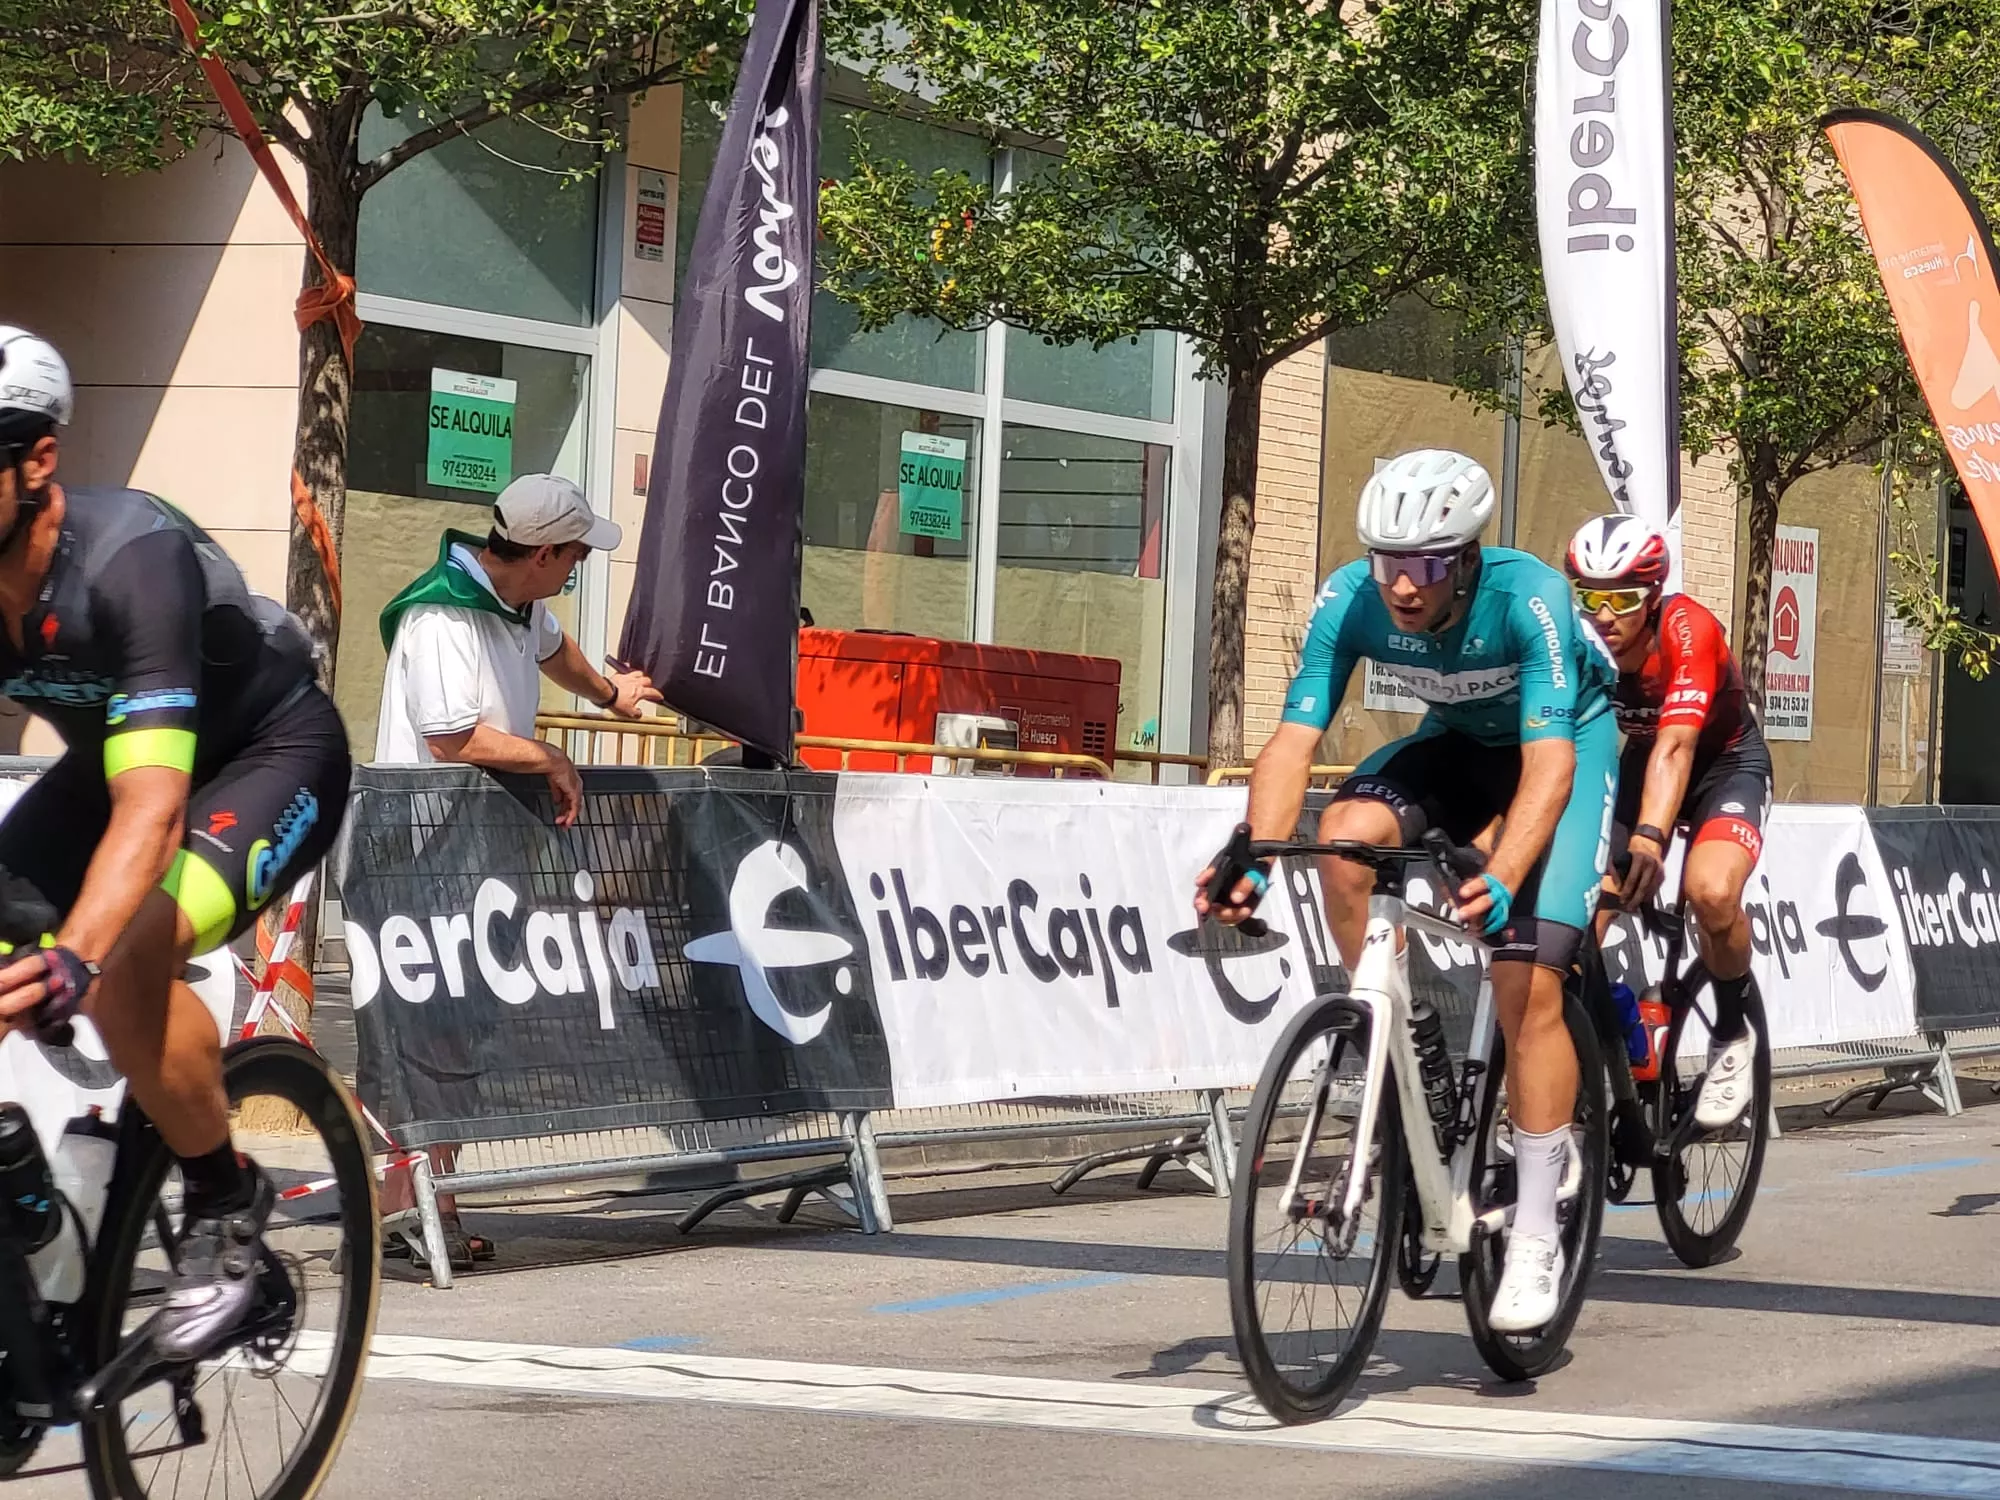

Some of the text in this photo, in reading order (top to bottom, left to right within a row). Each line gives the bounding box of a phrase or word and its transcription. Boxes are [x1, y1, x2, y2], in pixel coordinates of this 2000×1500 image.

[430, 404, 512, 439] SE ALQUILA
[442, 459, 497, 482] 974238244
[900, 463, 962, 491] SE ALQUILA
[1773, 537, 1815, 576] ALQUILER
[1528, 596, 1568, 690] CONTROLPACK
[1769, 696, 1781, 710] 974
[1782, 696, 1790, 711] 21
[1791, 697, 1801, 711] 53
[1021, 709, 1071, 728] Ayuntamiento
[1030, 730, 1057, 745] Huesca
[868, 867, 1154, 1008] iberCaja
